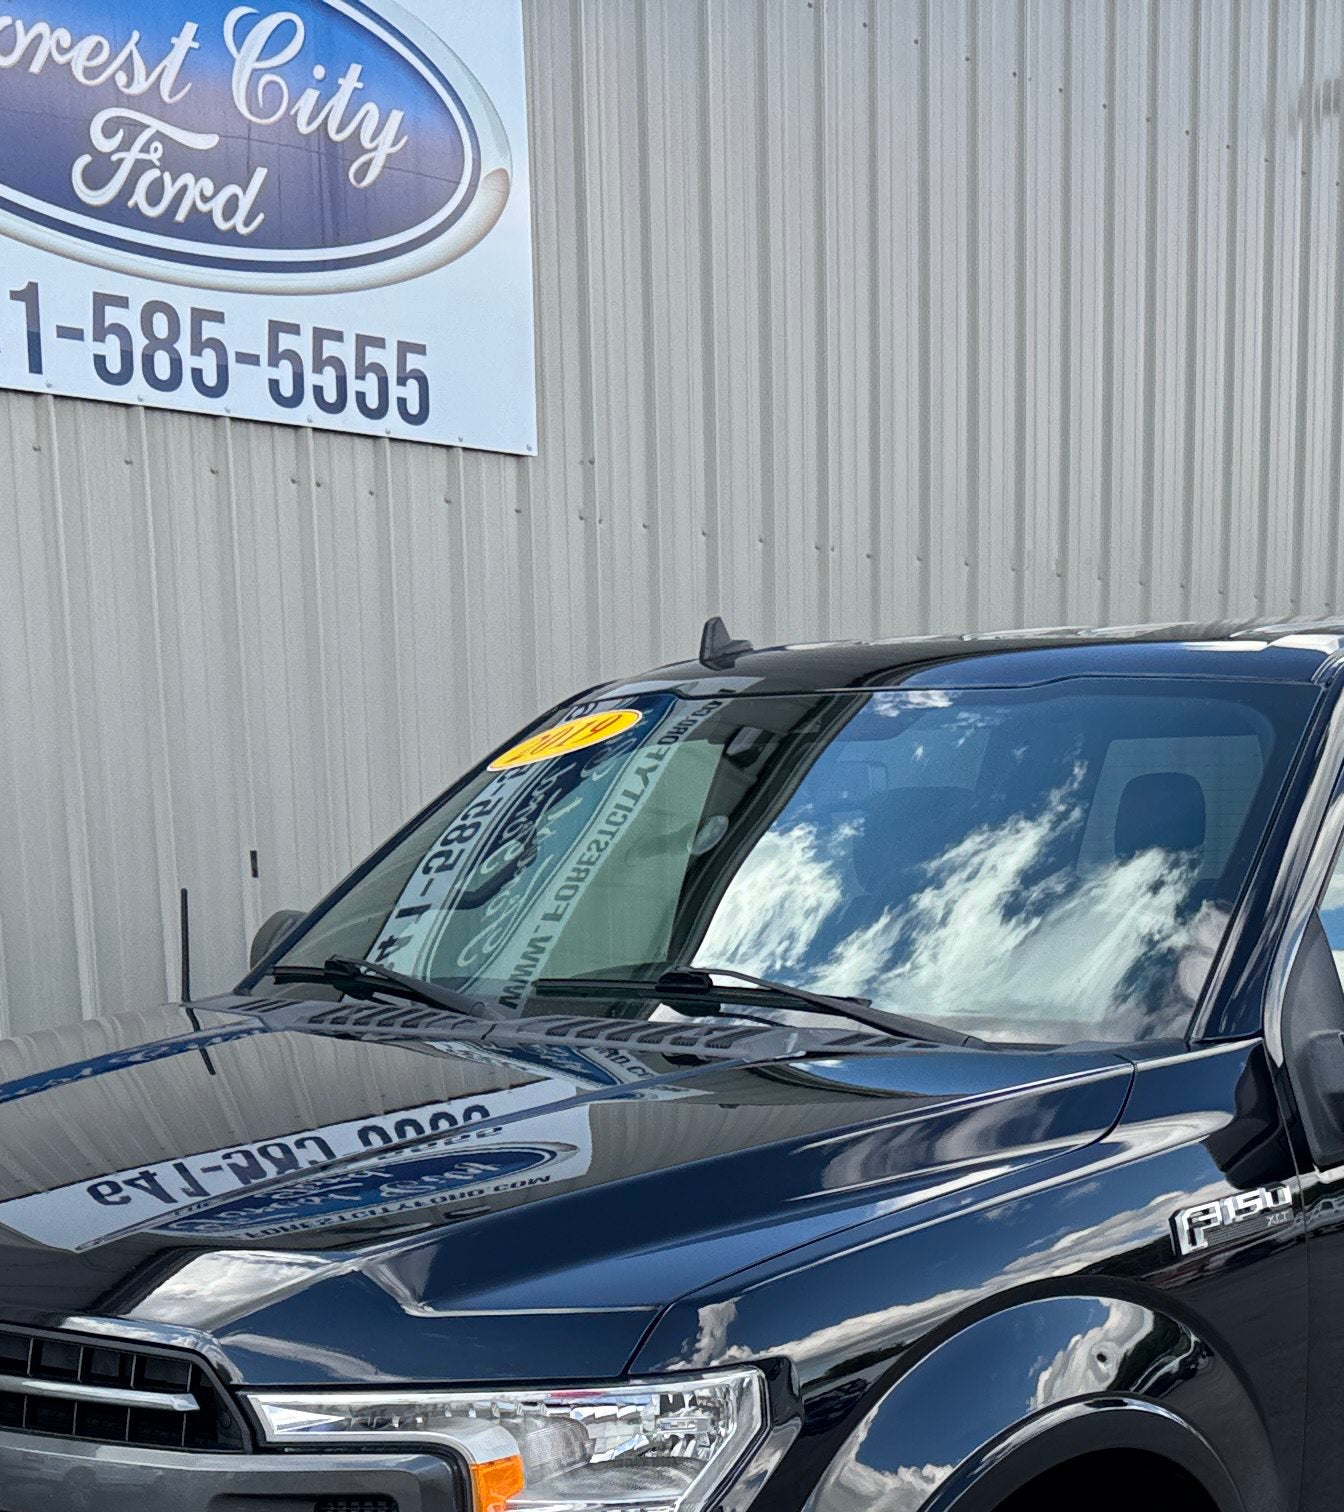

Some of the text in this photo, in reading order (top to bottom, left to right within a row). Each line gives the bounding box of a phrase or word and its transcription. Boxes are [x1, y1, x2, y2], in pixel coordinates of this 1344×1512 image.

[223, 6, 408, 189] City
[71, 107, 268, 236] Ford
[1266, 1209, 1290, 1228] XLT
